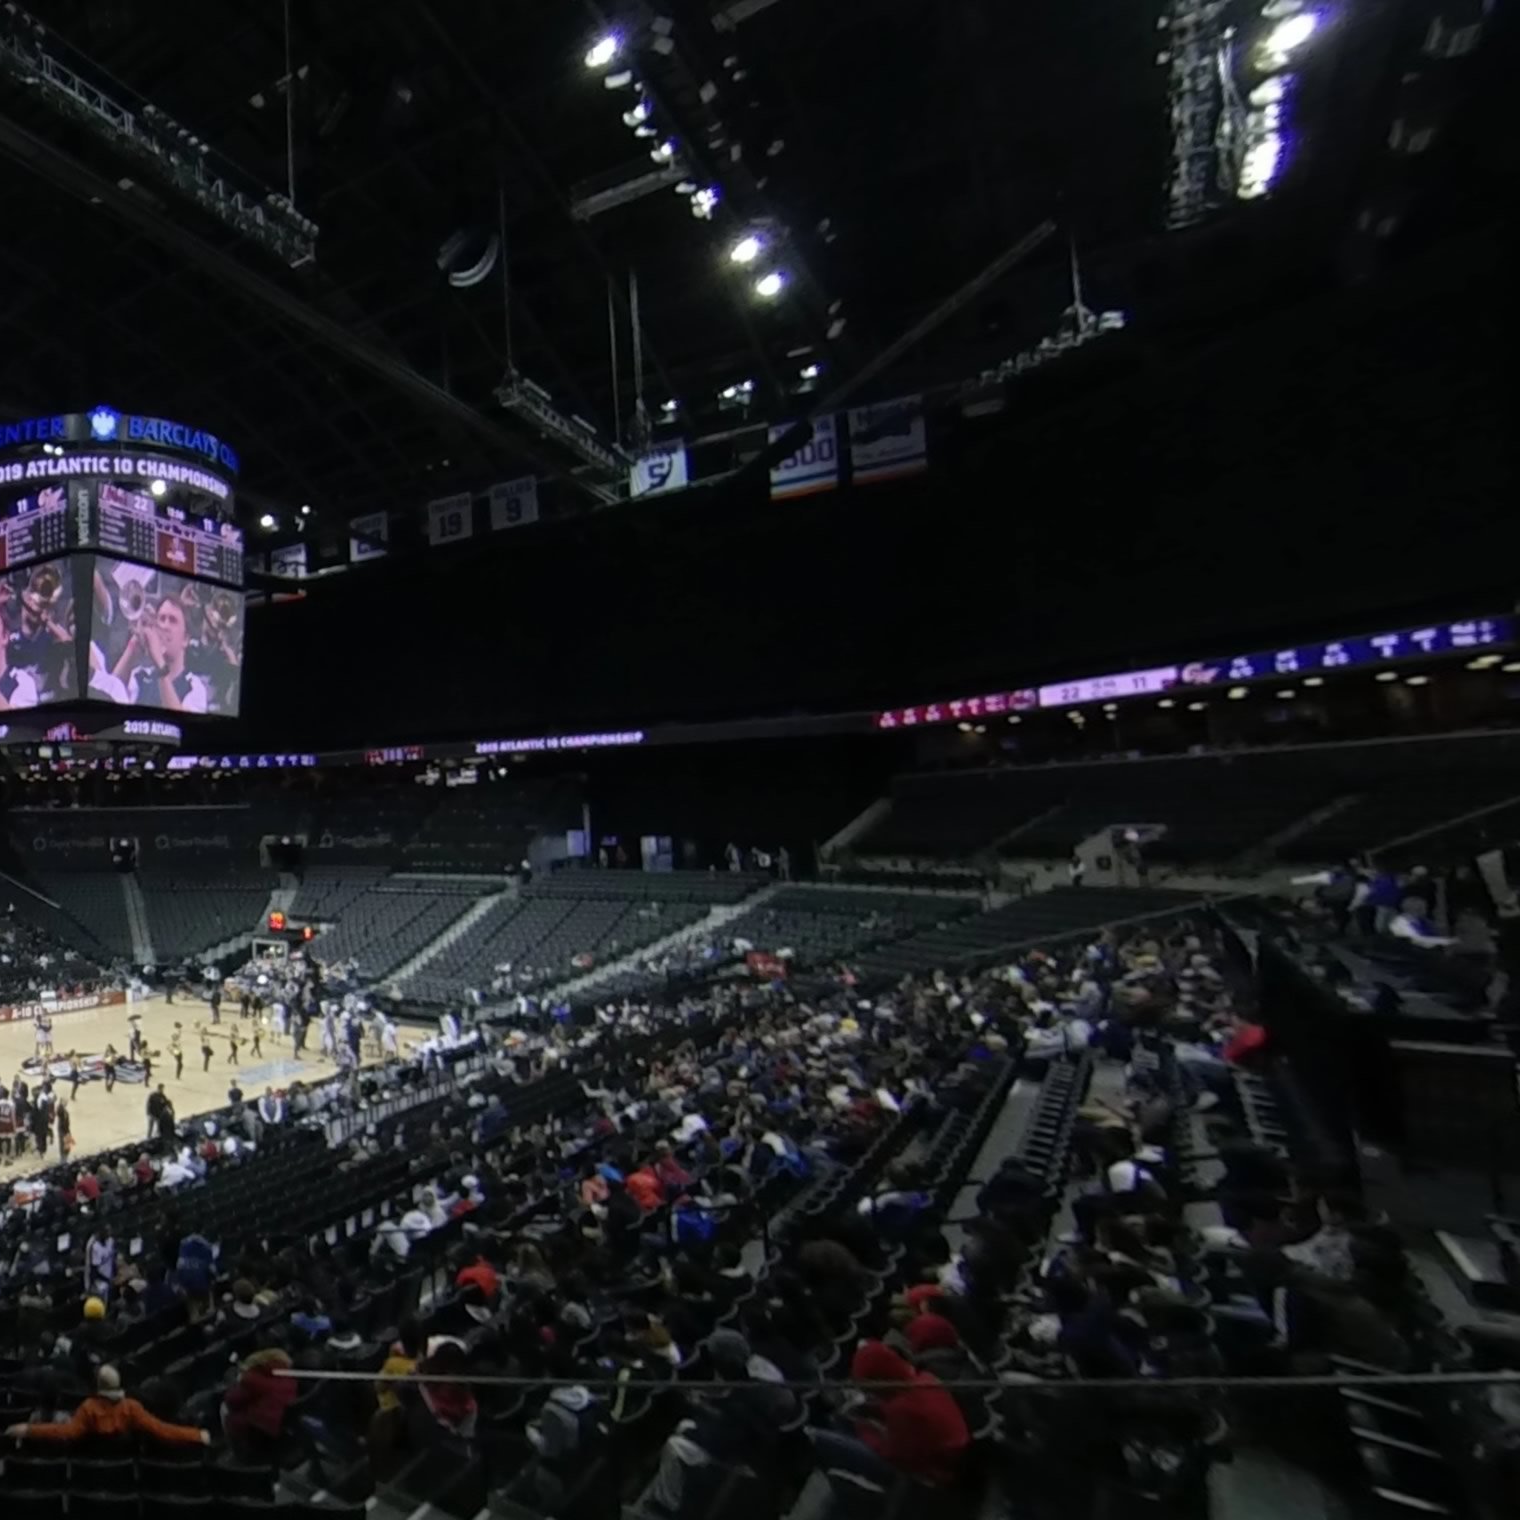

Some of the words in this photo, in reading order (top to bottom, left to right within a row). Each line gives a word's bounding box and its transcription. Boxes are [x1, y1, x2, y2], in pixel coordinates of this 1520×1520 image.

[128, 416, 217, 461] BARCLAYS
[26, 457, 108, 478] ATLANTIC
[113, 457, 132, 474] 10
[136, 457, 229, 499] CHAMPIONSHIP
[17, 498, 28, 514] 11
[134, 496, 148, 511] 22
[506, 498, 521, 523] 9
[203, 518, 214, 533] 11
[439, 512, 462, 538] 19
[1061, 686, 1079, 701] 22
[123, 720, 149, 735] 2019
[499, 739, 546, 753] ATLANTIC
[560, 732, 644, 749] CHAMPIONSHIP
